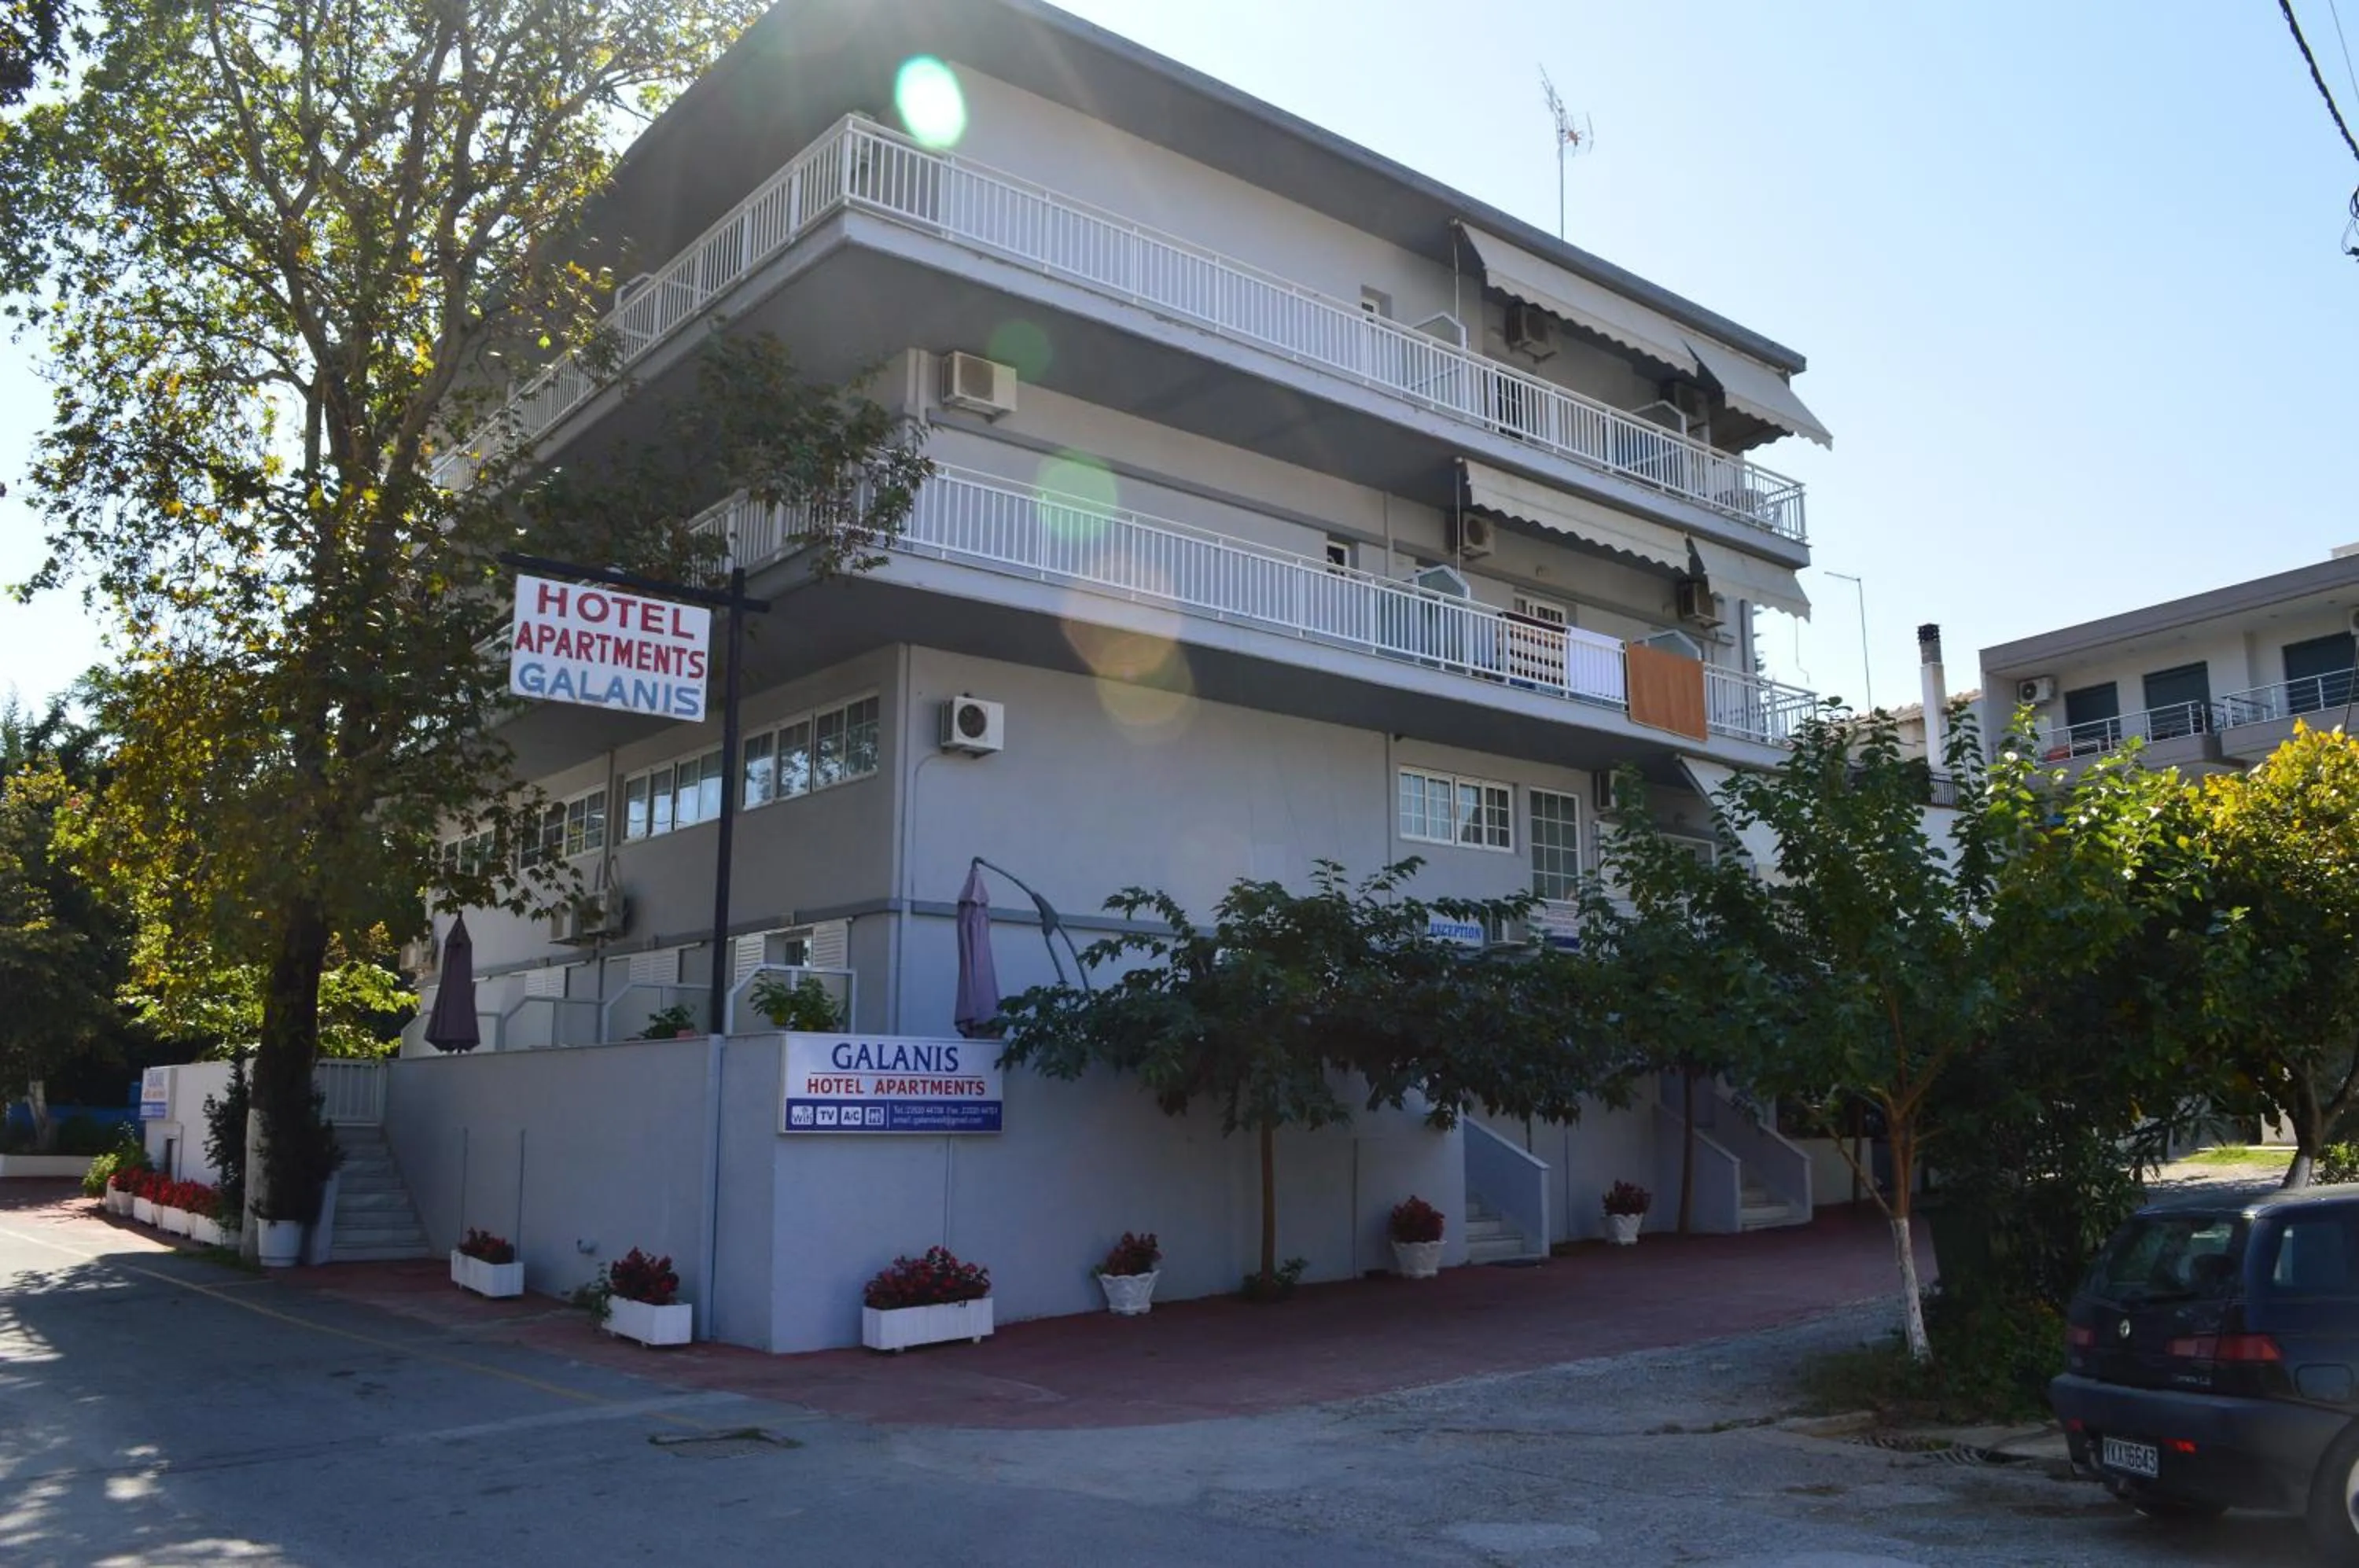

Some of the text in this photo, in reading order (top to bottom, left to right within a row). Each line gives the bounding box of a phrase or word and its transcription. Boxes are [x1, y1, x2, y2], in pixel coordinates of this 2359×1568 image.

[537, 583, 695, 640] HOTEL
[514, 620, 705, 679] APARTMENTS
[518, 662, 701, 716] GALANIS
[831, 1043, 959, 1073] GALANIS
[807, 1078, 985, 1096] HOTEL APARTMENTS
[820, 1110, 834, 1121] TV
